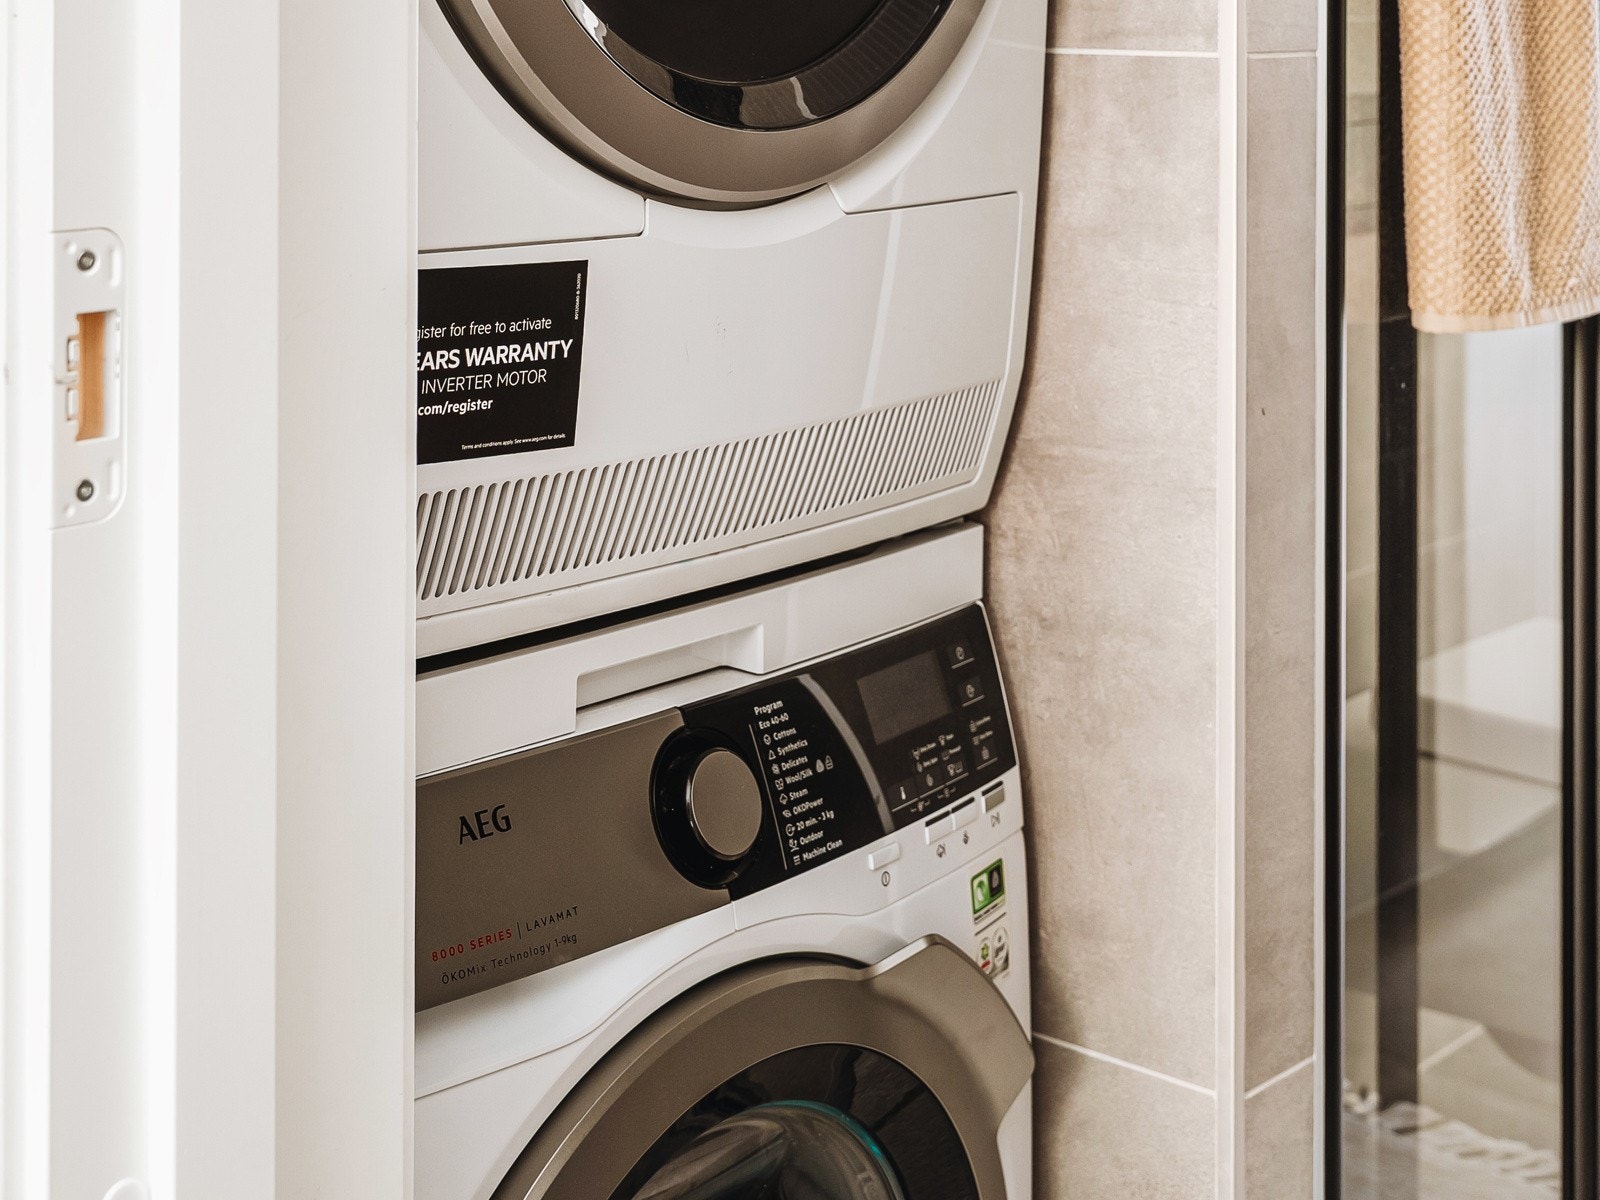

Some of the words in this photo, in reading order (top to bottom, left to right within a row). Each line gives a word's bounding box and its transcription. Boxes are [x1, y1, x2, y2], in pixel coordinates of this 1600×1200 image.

[449, 322, 466, 337] for
[469, 321, 491, 336] free
[495, 321, 506, 333] to
[509, 317, 552, 332] activate
[464, 338, 573, 367] WARRANTY
[421, 373, 493, 395] INVERTER
[496, 368, 547, 388] MOTOR
[417, 398, 493, 416] com/register
[753, 700, 784, 716] Program
[758, 720, 771, 730] Eco
[770, 712, 789, 724] 40-60
[773, 727, 797, 740] Cottons
[777, 739, 808, 756] Synthetics
[781, 755, 808, 771] Delicates
[784, 767, 813, 784] Wool/Silk
[789, 788, 809, 801] Steam
[458, 803, 513, 846] AEG
[796, 820, 805, 831] 20
[799, 830, 824, 845] Outdoor
[802, 846, 827, 861] Machine
[826, 839, 843, 851] Clean
[431, 943, 464, 962] 8000
[469, 928, 513, 950] SERIES
[525, 905, 578, 932] LAVAMAT
[491, 942, 551, 969] Technology
[553, 933, 578, 949] 1-9kg
